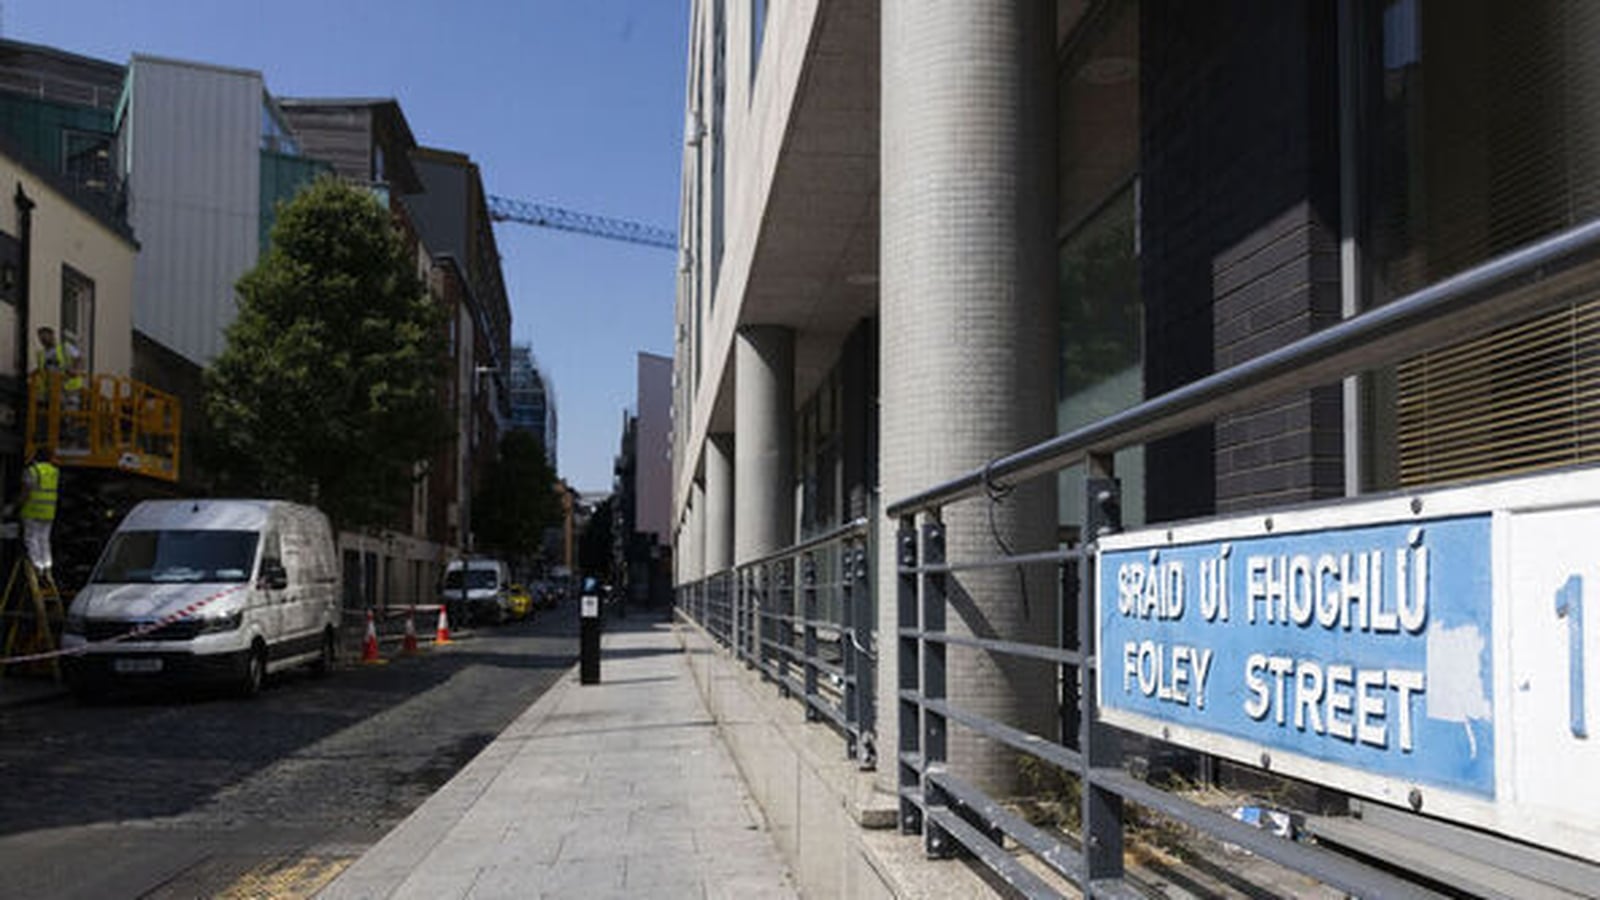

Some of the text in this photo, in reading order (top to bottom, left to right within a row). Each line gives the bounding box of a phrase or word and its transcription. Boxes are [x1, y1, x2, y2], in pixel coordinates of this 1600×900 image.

[1118, 527, 1430, 635] SRÁID UÍ FHOGHLÚ
[1123, 640, 1425, 753] FOLEY STREET
[1555, 573, 1588, 739] 1
